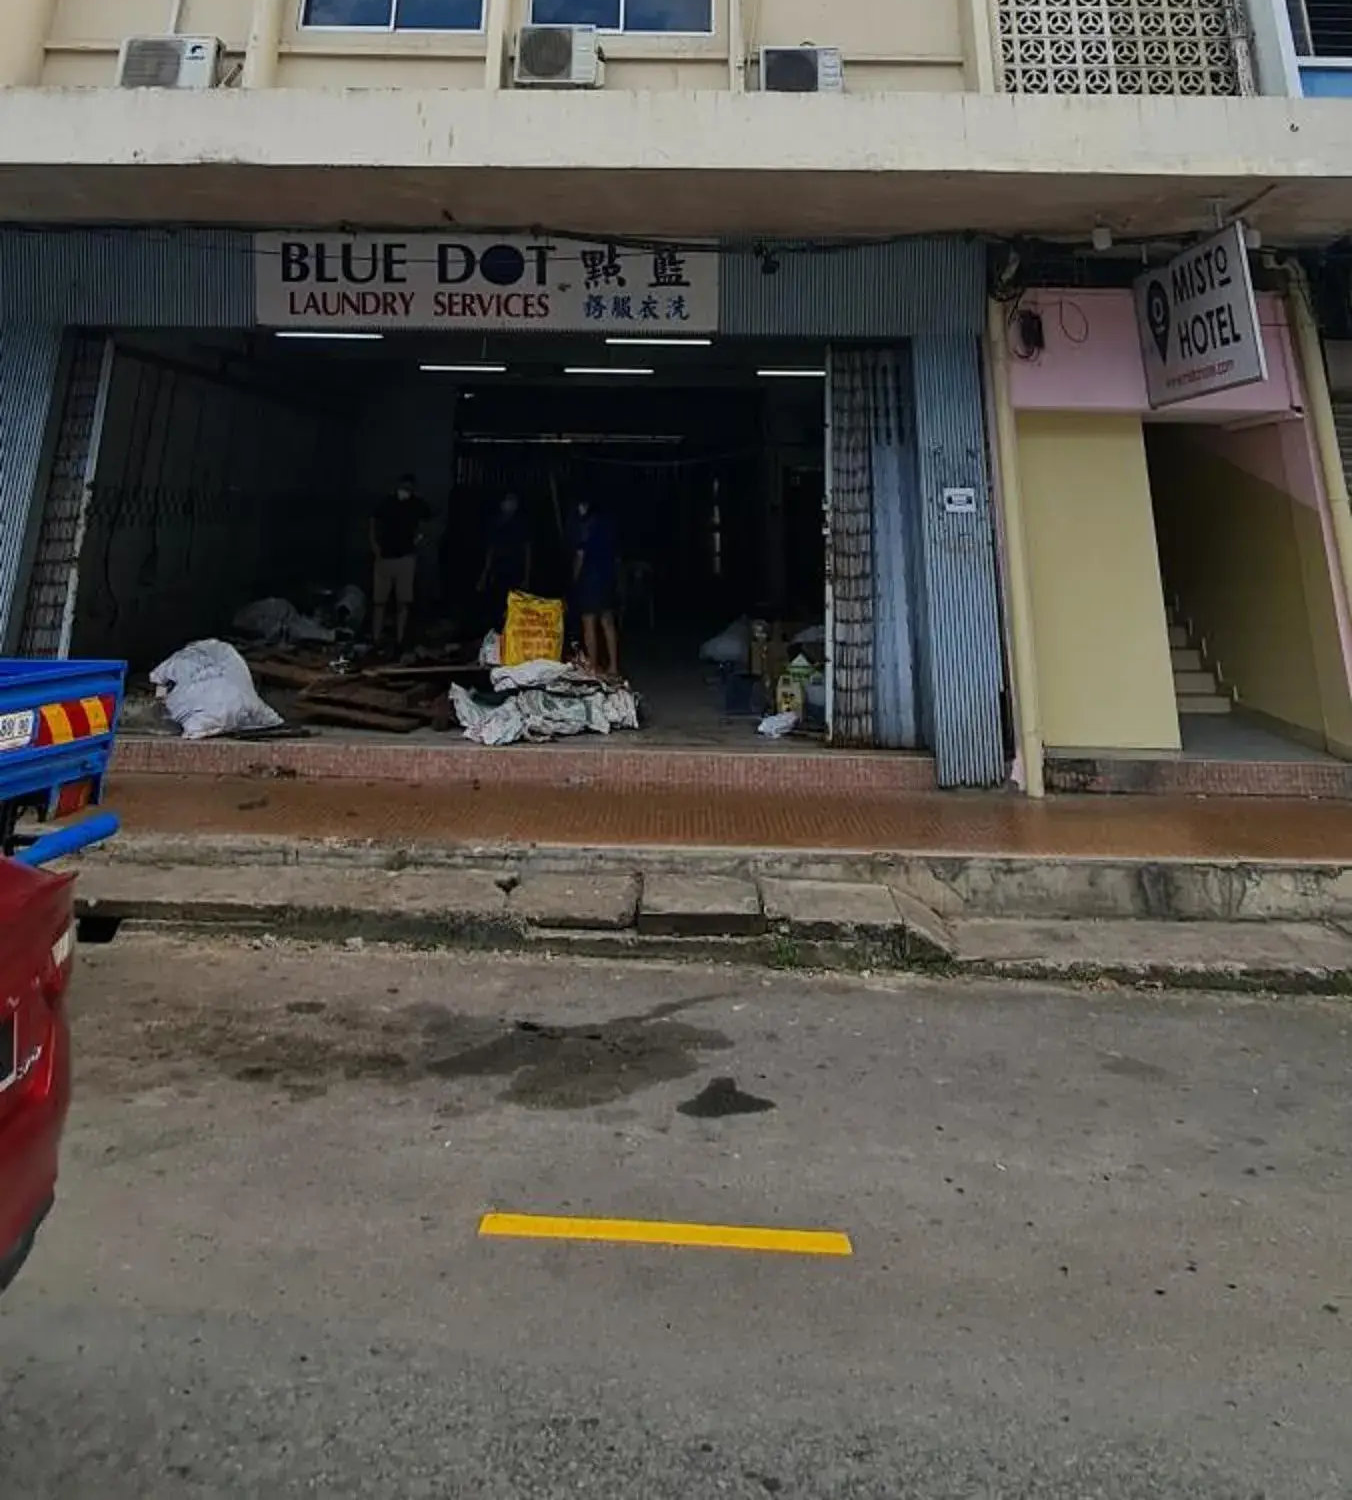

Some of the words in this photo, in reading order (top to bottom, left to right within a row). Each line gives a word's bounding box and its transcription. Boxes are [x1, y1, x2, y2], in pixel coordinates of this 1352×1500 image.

[281, 243, 407, 284] BLUE
[437, 243, 557, 286] DOT
[1171, 245, 1232, 307] MISTO
[289, 291, 415, 317] LAUNDRY
[433, 292, 550, 319] SERVICES
[1177, 303, 1242, 360] HOTEL
